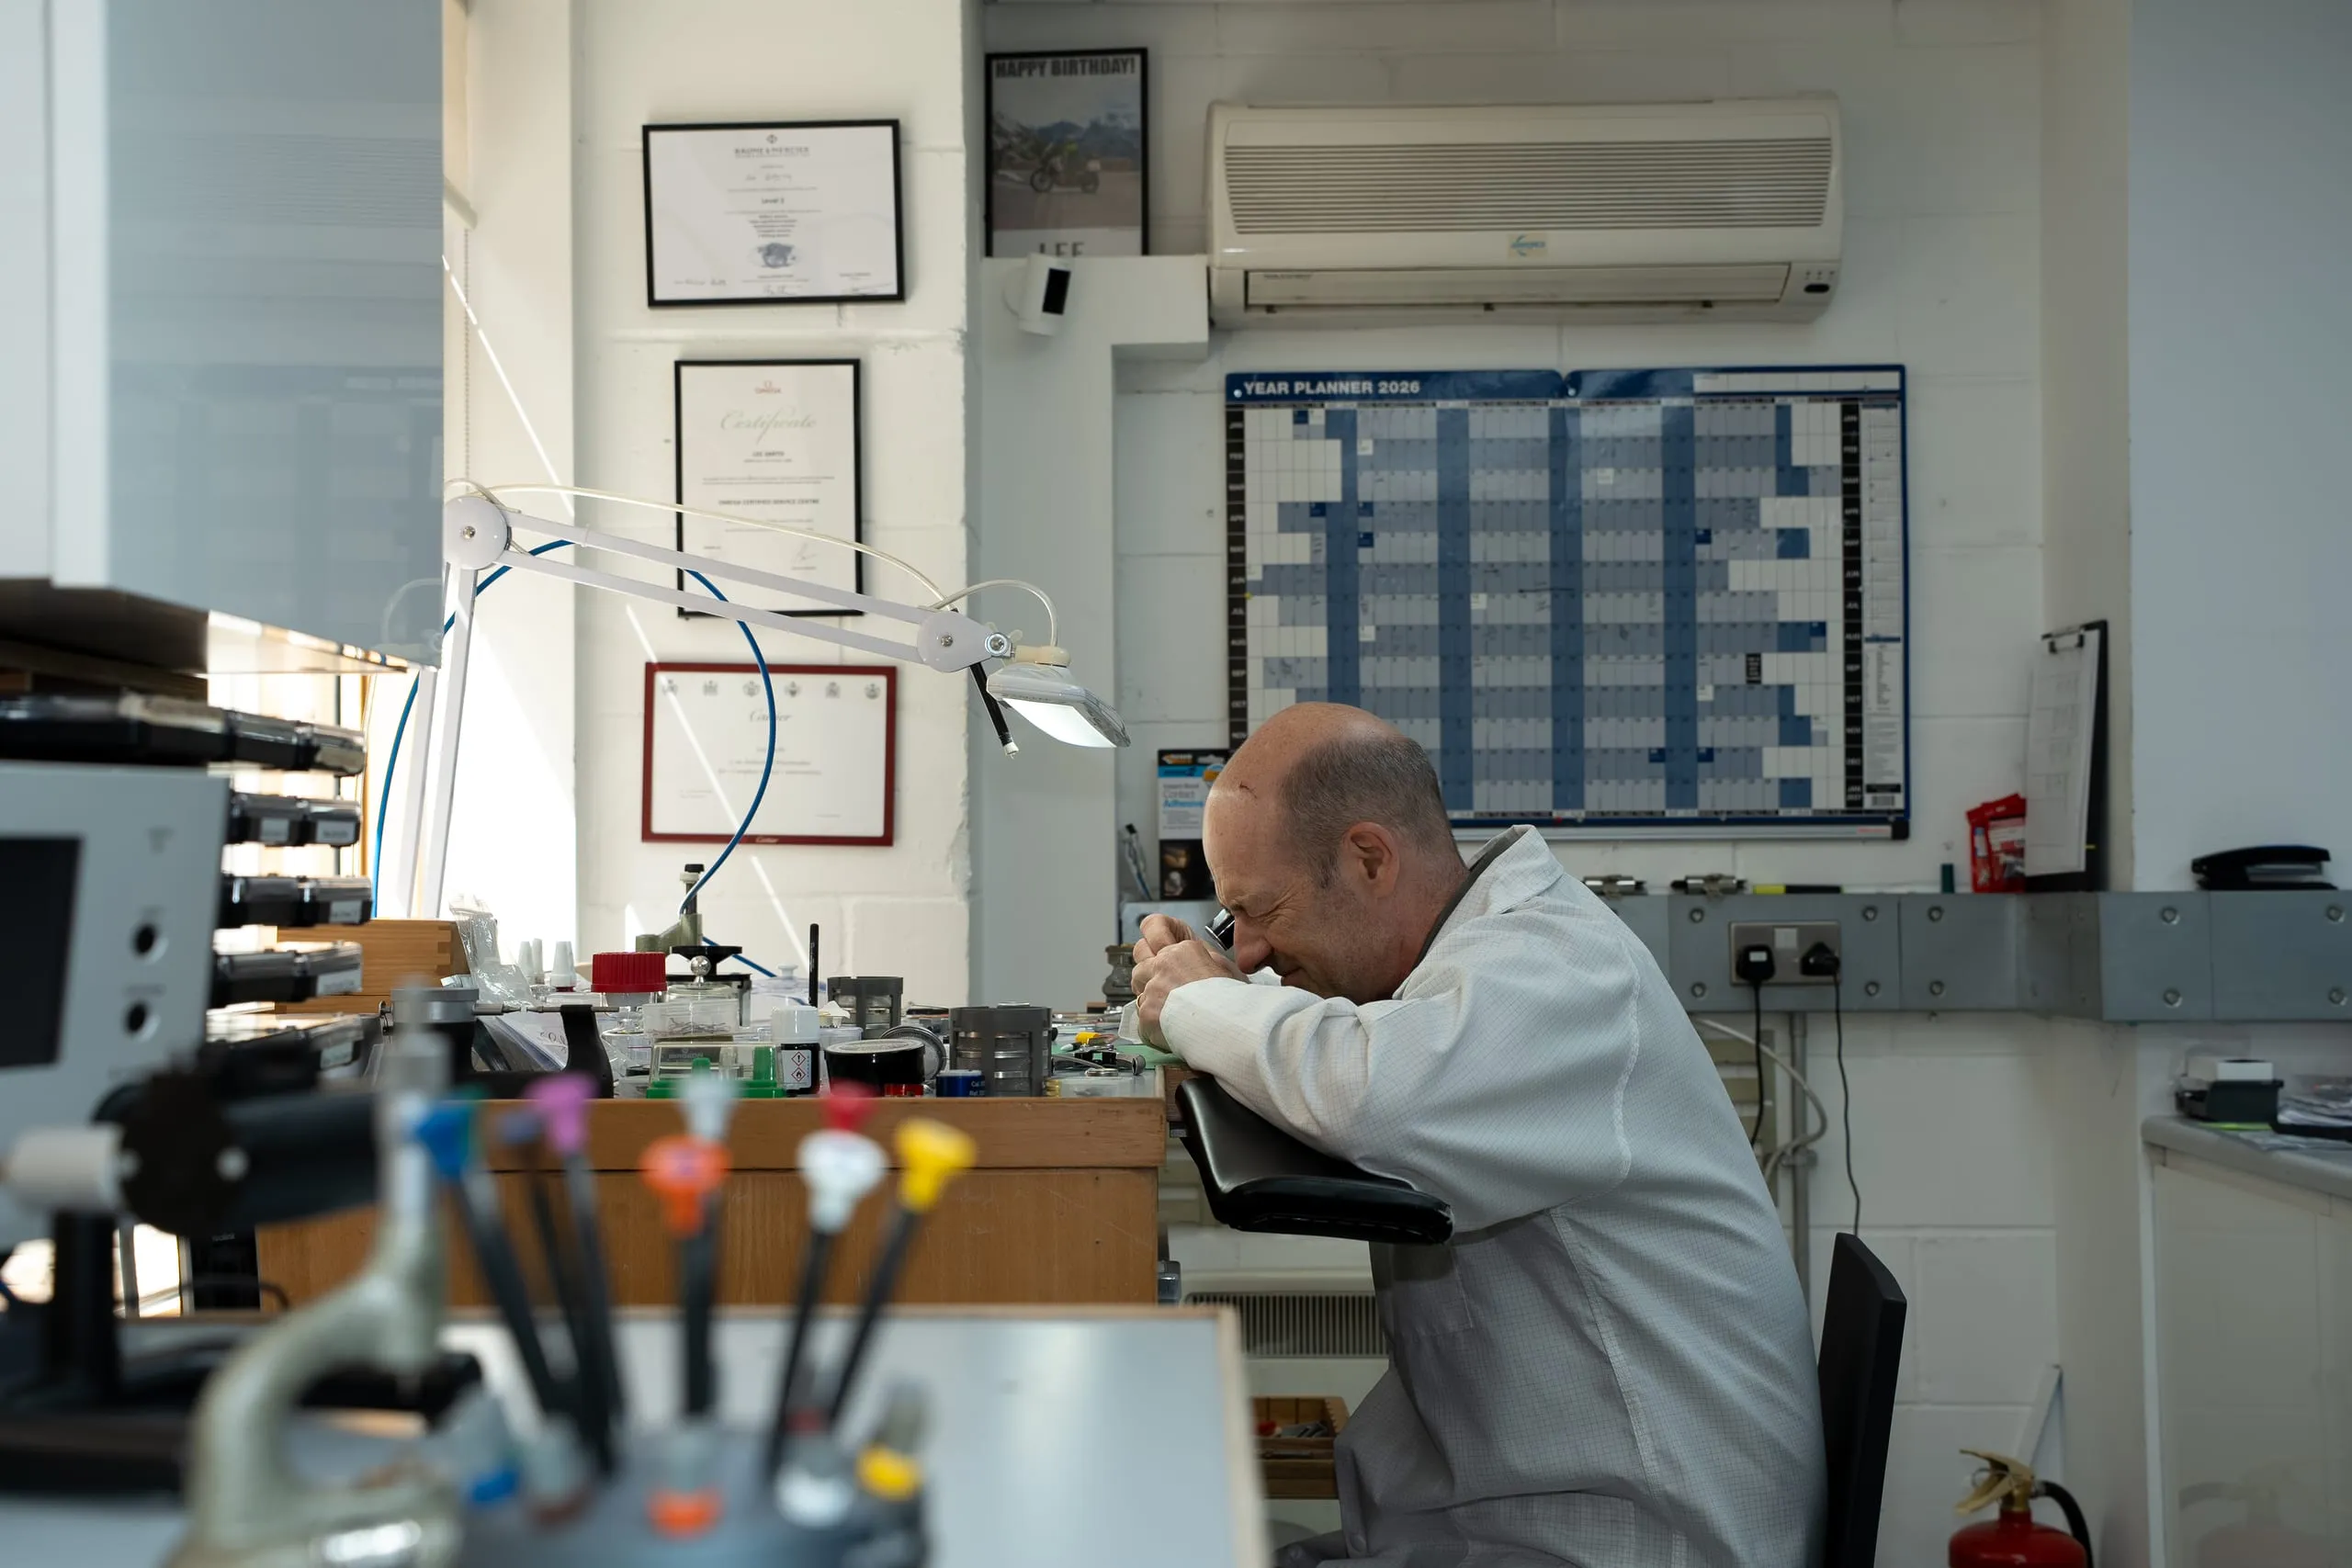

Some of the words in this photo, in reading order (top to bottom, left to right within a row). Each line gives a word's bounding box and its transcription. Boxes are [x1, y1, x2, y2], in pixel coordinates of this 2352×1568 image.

[995, 60, 1047, 78] HAPPY
[1051, 57, 1136, 76] BIRTHDAY!
[1243, 381, 1290, 395] YEAR
[1294, 381, 1374, 395] PLANNER
[1378, 380, 1420, 394] 2026
